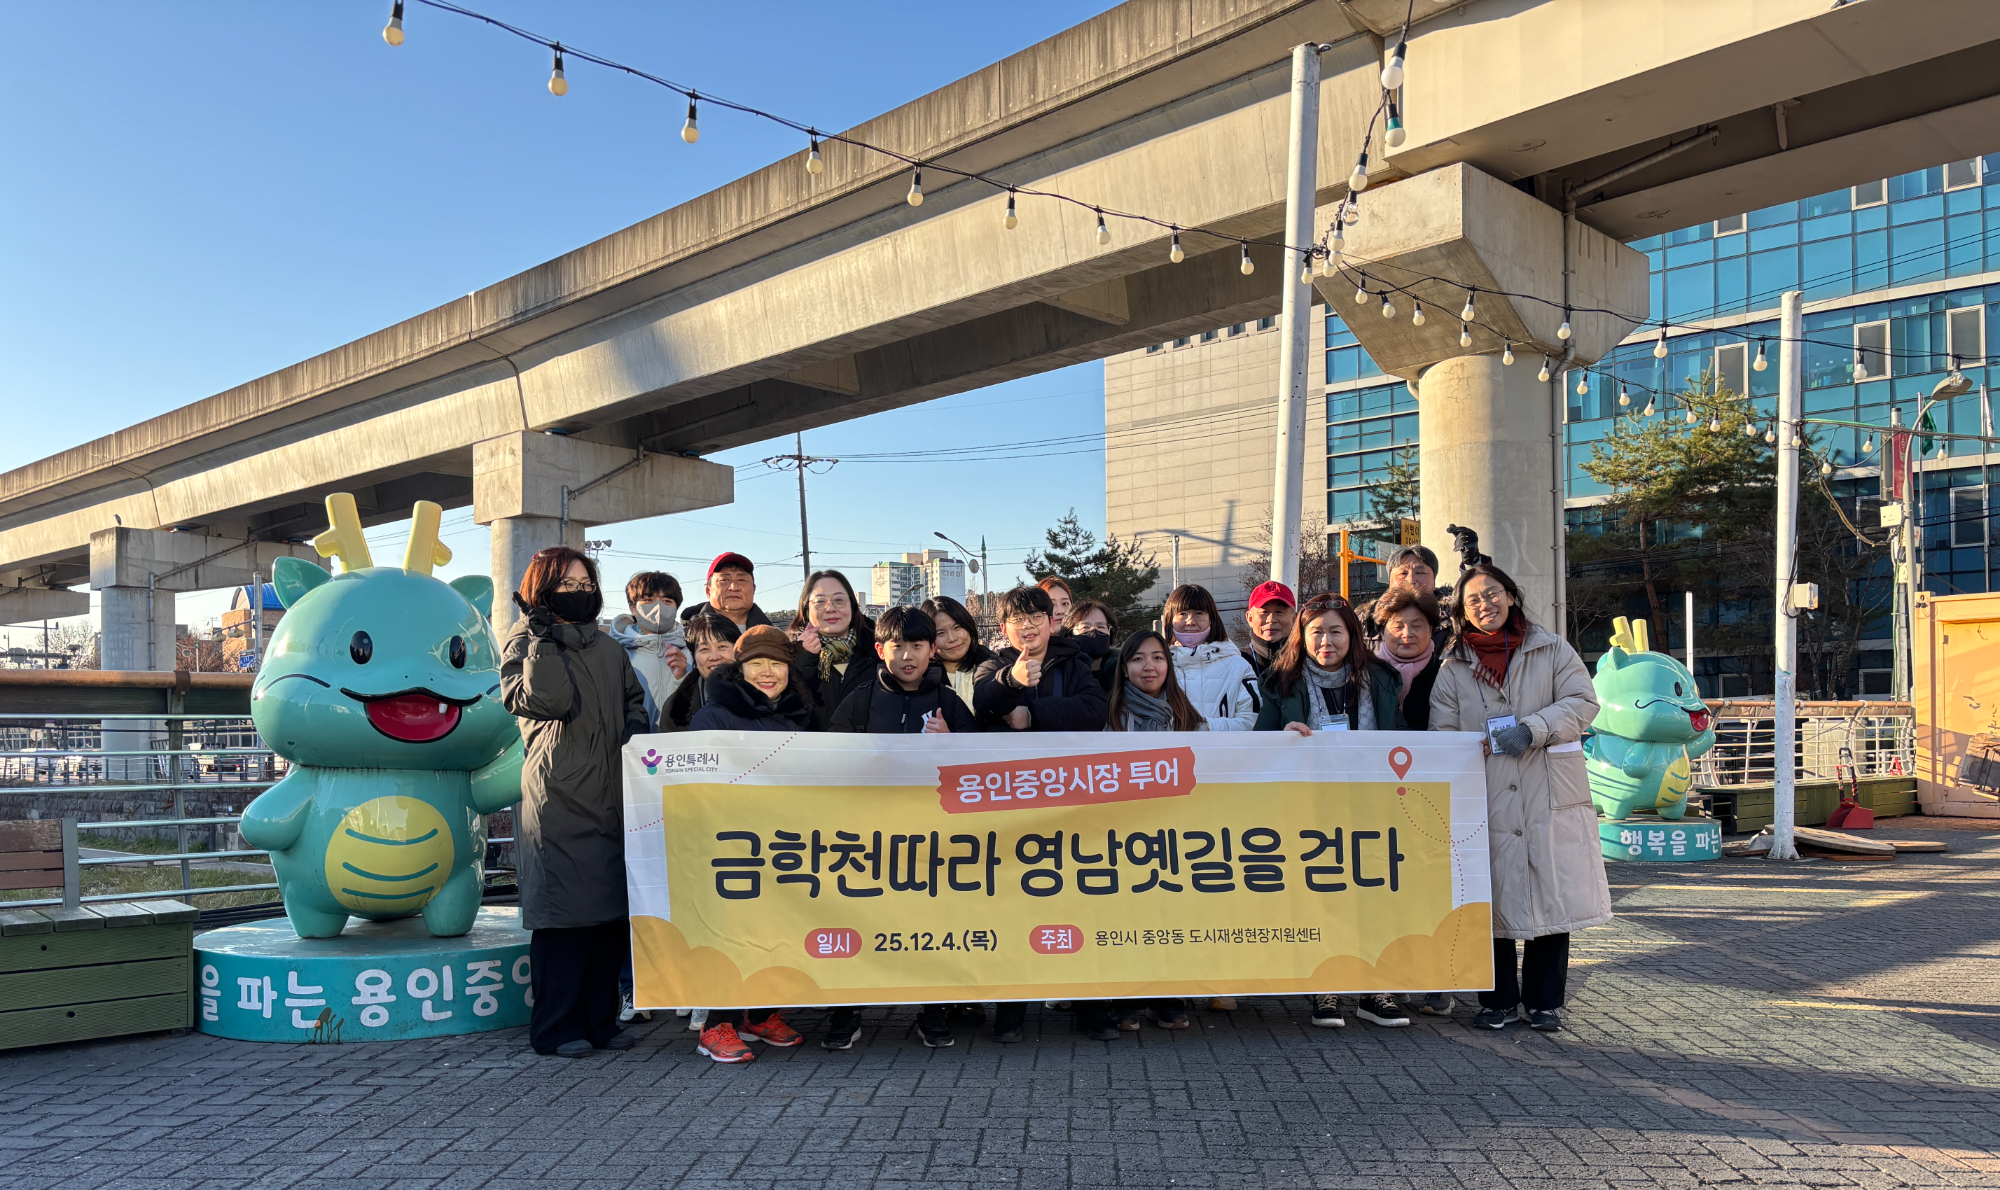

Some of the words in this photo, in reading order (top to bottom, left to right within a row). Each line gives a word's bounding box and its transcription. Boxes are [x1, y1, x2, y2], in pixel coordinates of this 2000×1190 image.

[664, 752, 719, 768] 용인특례시
[956, 763, 1121, 804] 용인중앙시장
[1128, 757, 1179, 790] 투어
[1620, 829, 1688, 856] 행복을
[1695, 829, 1719, 854] 파는
[711, 829, 1002, 900] 금학천따라
[1015, 826, 1287, 897] 영남옛길을
[1298, 826, 1405, 893] 걷다
[816, 932, 850, 954] 일시
[873, 929, 998, 953] 25.12.4.(목)
[1040, 928, 1073, 950] 주최
[1094, 929, 1138, 947] 용인시
[1141, 928, 1185, 945] 중앙동
[1188, 926, 1322, 944] 도시재생현장지원센터
[200, 964, 222, 1022] 을
[236, 970, 326, 1029] 파는
